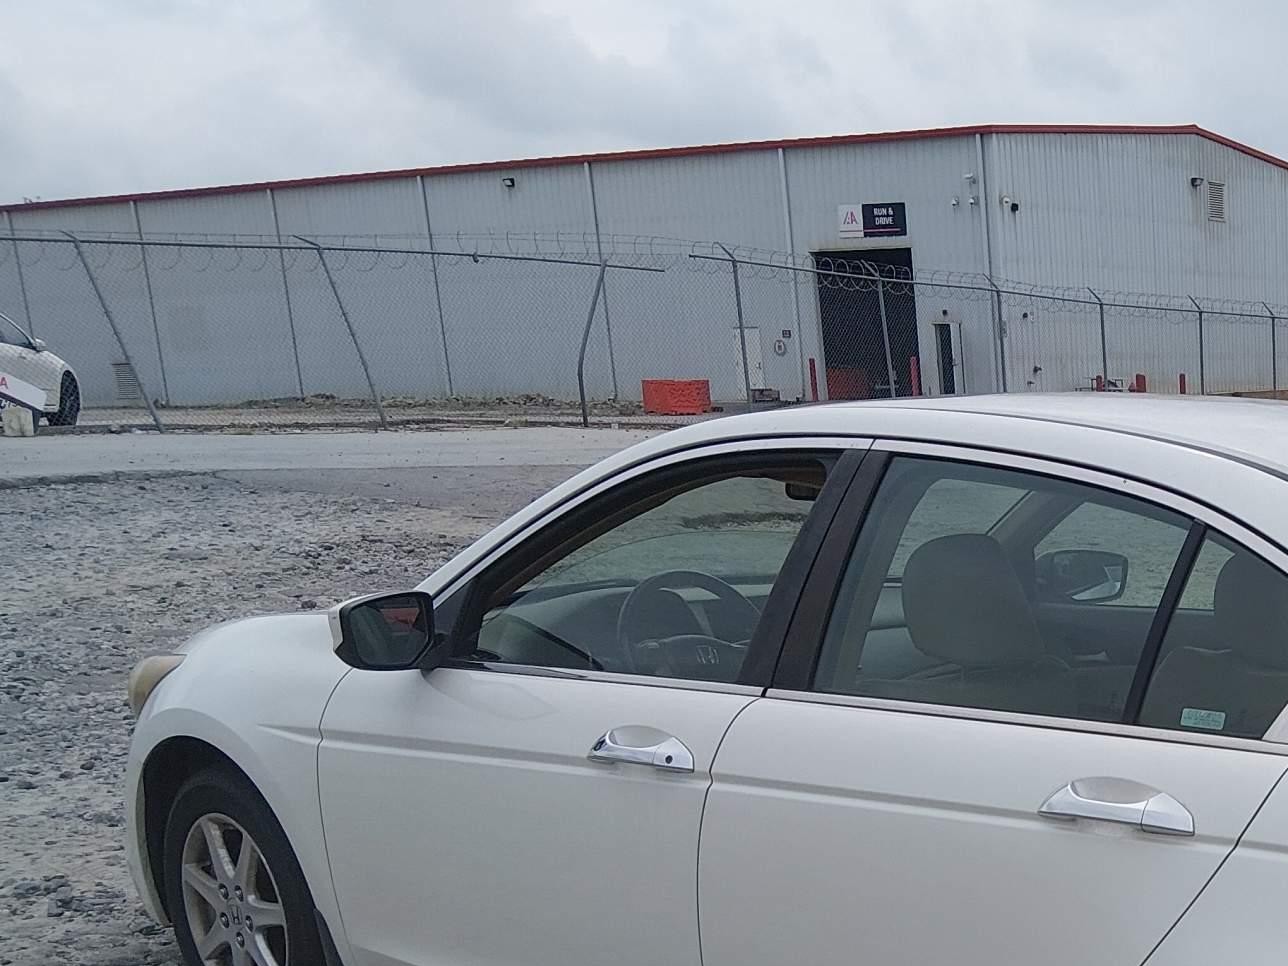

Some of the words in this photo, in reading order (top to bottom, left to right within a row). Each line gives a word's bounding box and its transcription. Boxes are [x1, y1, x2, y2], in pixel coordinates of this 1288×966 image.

[873, 207, 887, 216] RUN
[888, 207, 894, 216] &
[875, 216, 895, 226] DRIVE
